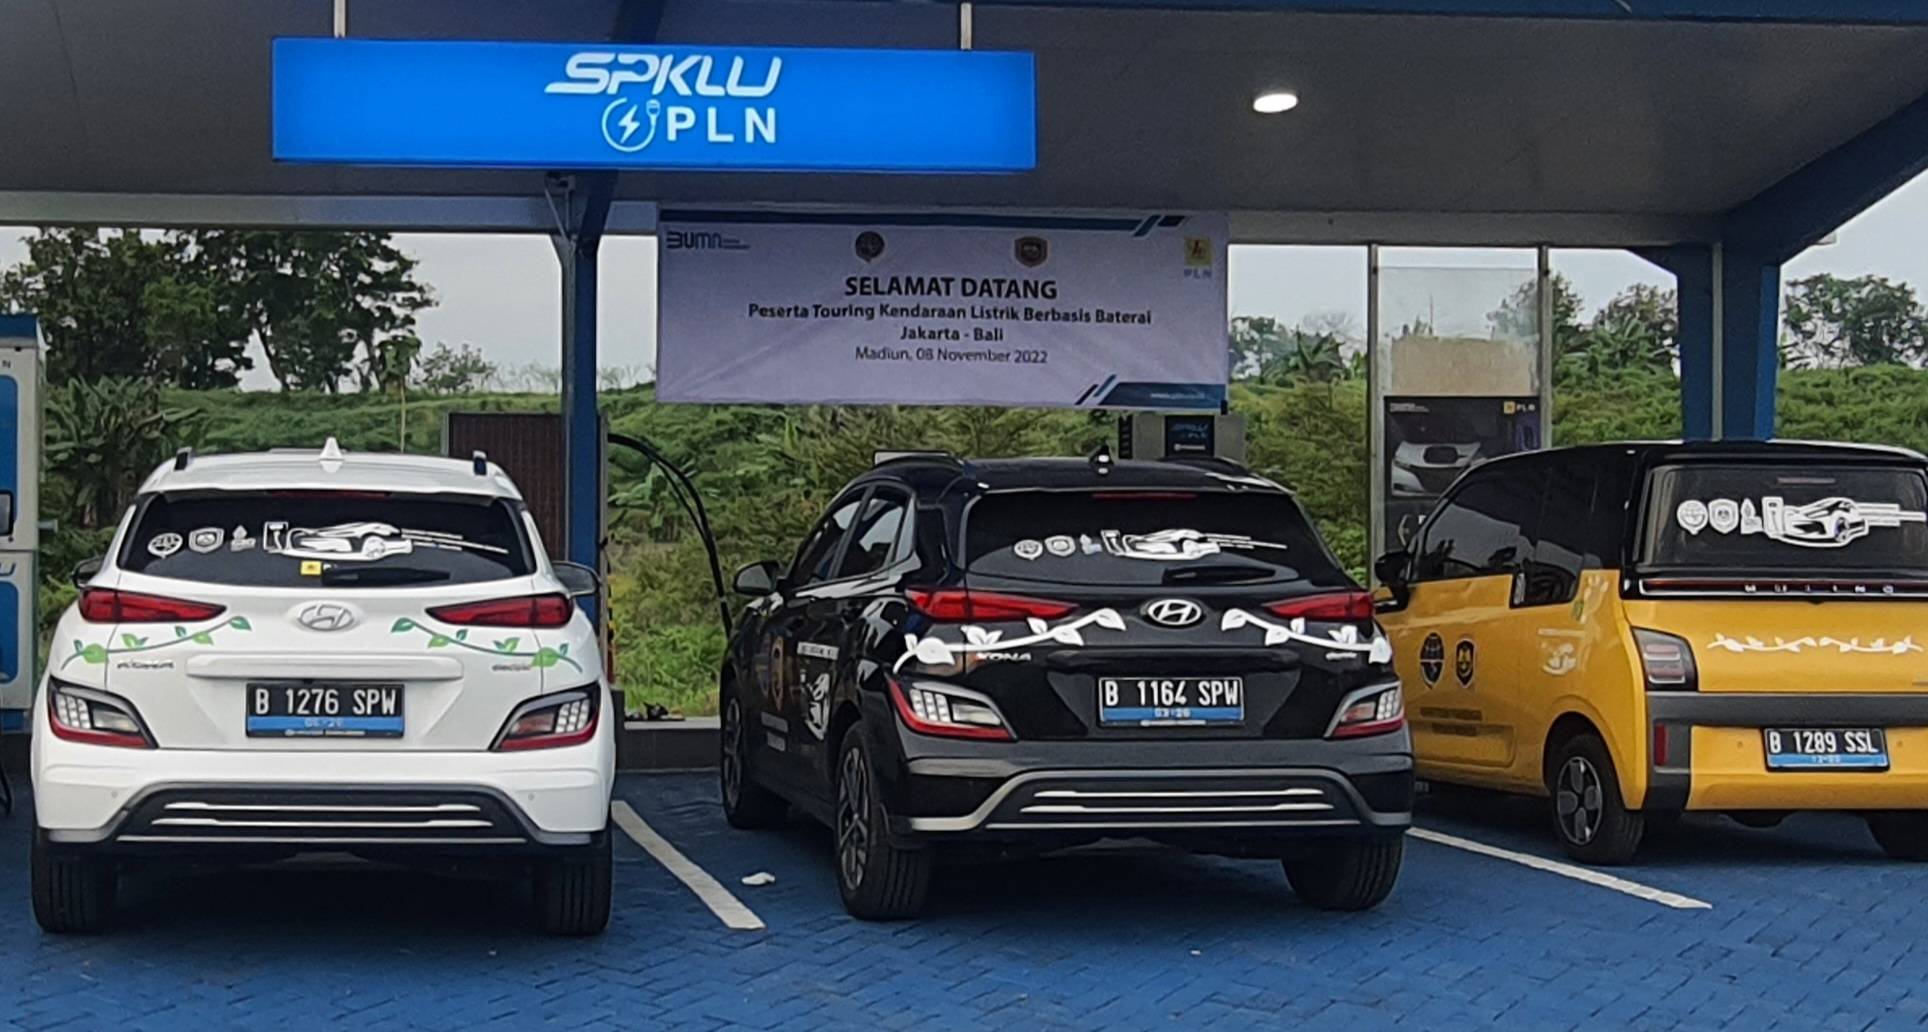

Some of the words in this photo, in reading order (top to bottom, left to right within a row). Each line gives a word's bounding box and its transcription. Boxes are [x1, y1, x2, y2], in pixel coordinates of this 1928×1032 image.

[544, 52, 783, 97] SPKLU
[667, 106, 777, 143] PLN
[844, 276, 955, 297] SELAMAT
[961, 278, 1058, 300] DATANG
[748, 303, 809, 319] Peserta
[813, 303, 875, 321] Touring
[879, 303, 966, 320] Kendaraan
[970, 305, 1020, 320] Listrik
[1023, 307, 1092, 323] Berbasis
[1095, 309, 1152, 325] Baterai
[900, 326, 960, 341] Jakarta
[973, 327, 1004, 342] Bali
[855, 347, 913, 362] Madiun,
[916, 348, 935, 361] 08
[937, 348, 1010, 363] November
[1014, 350, 1049, 364] 2022
[255, 688, 270, 714] B
[286, 688, 340, 714] 1276
[352, 688, 397, 714] SPW
[1104, 680, 1119, 706] B
[1137, 680, 1187, 706] 1164
[1198, 680, 1239, 706] SPW
[1769, 731, 1782, 754] B
[1793, 731, 1838, 754] 1289
[1844, 731, 1880, 754] SSL
